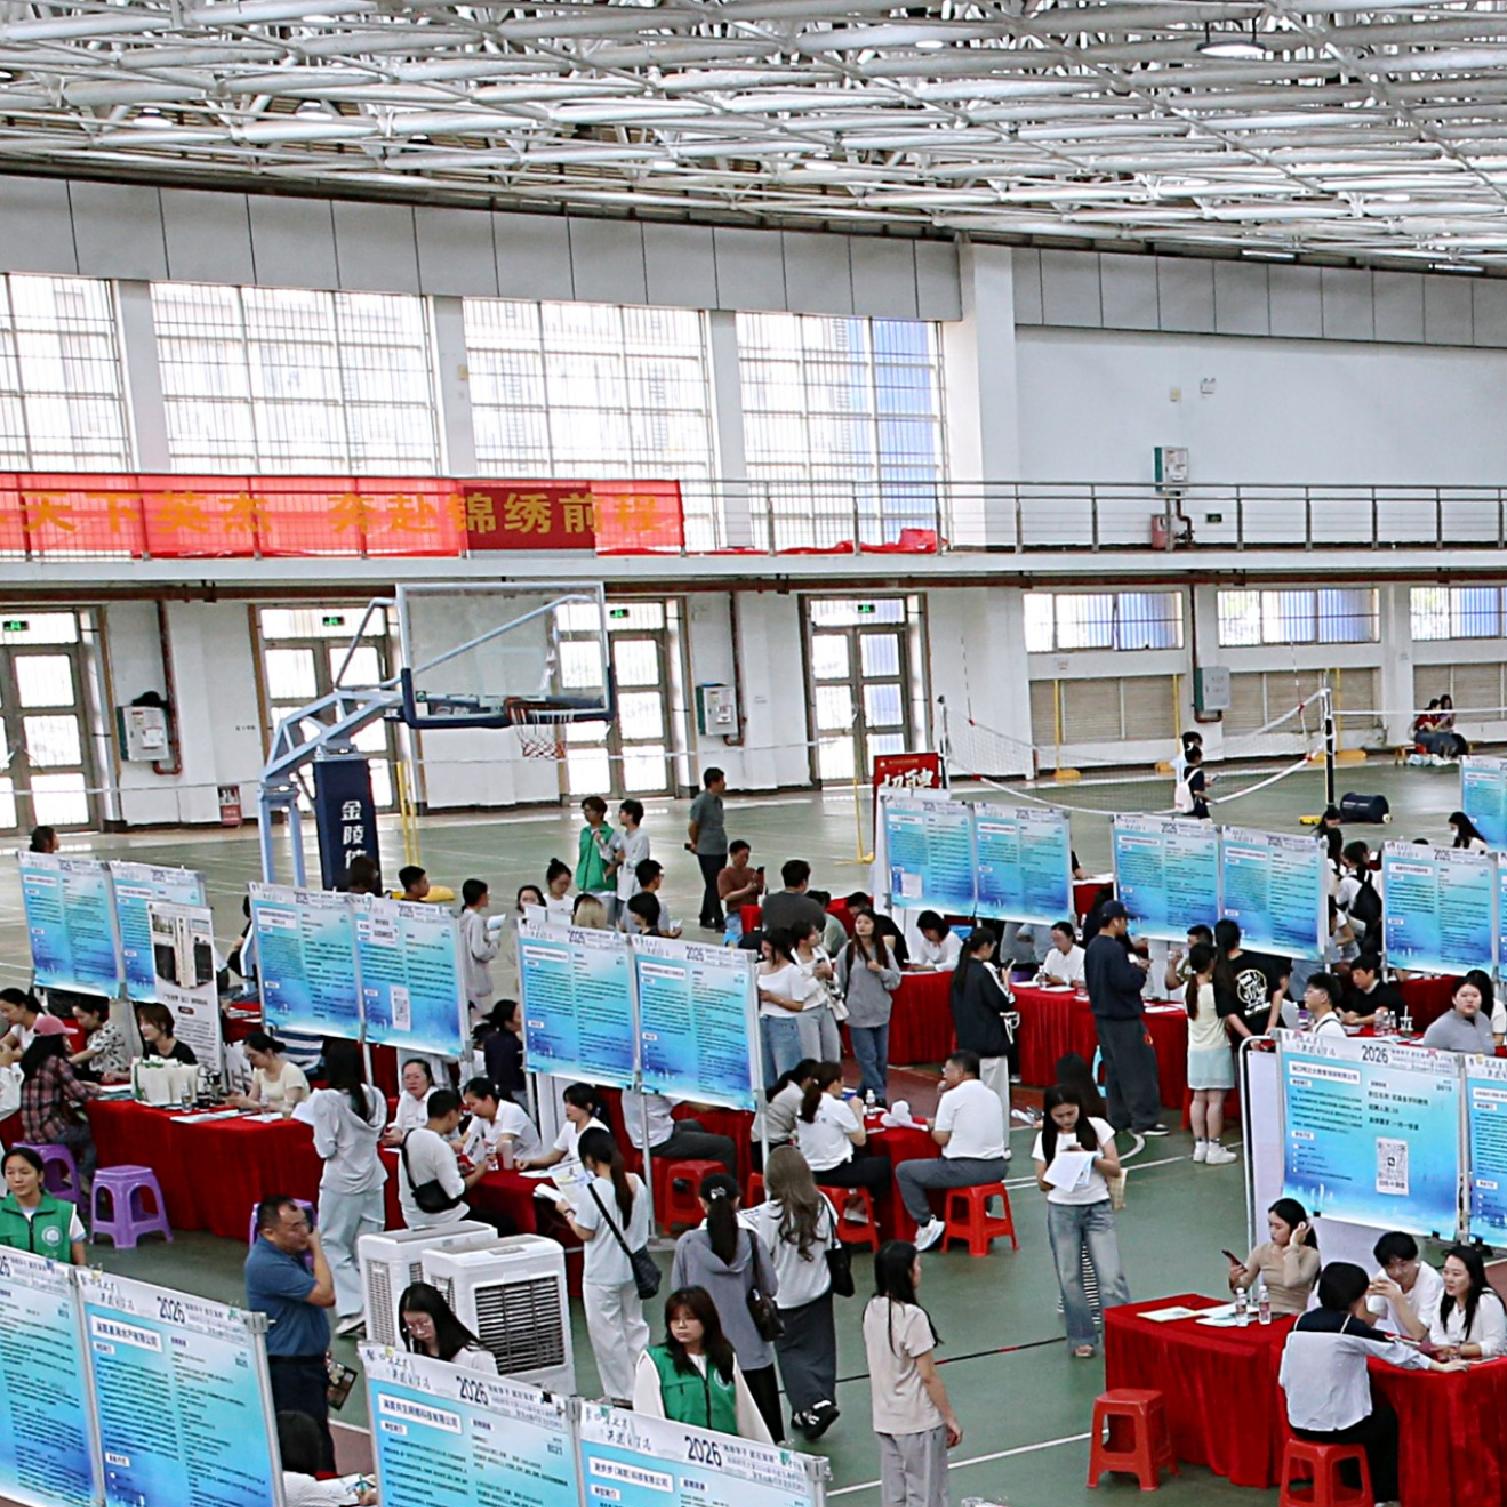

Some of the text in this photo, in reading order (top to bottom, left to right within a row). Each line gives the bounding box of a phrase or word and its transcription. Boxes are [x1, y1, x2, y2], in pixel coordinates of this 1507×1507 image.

[0, 489, 660, 535] 天下英杰 奔赴锦绣前程
[1362, 1045, 1389, 1064] 2026
[457, 1375, 489, 1406] 2026
[684, 1436, 722, 1467] 2026
